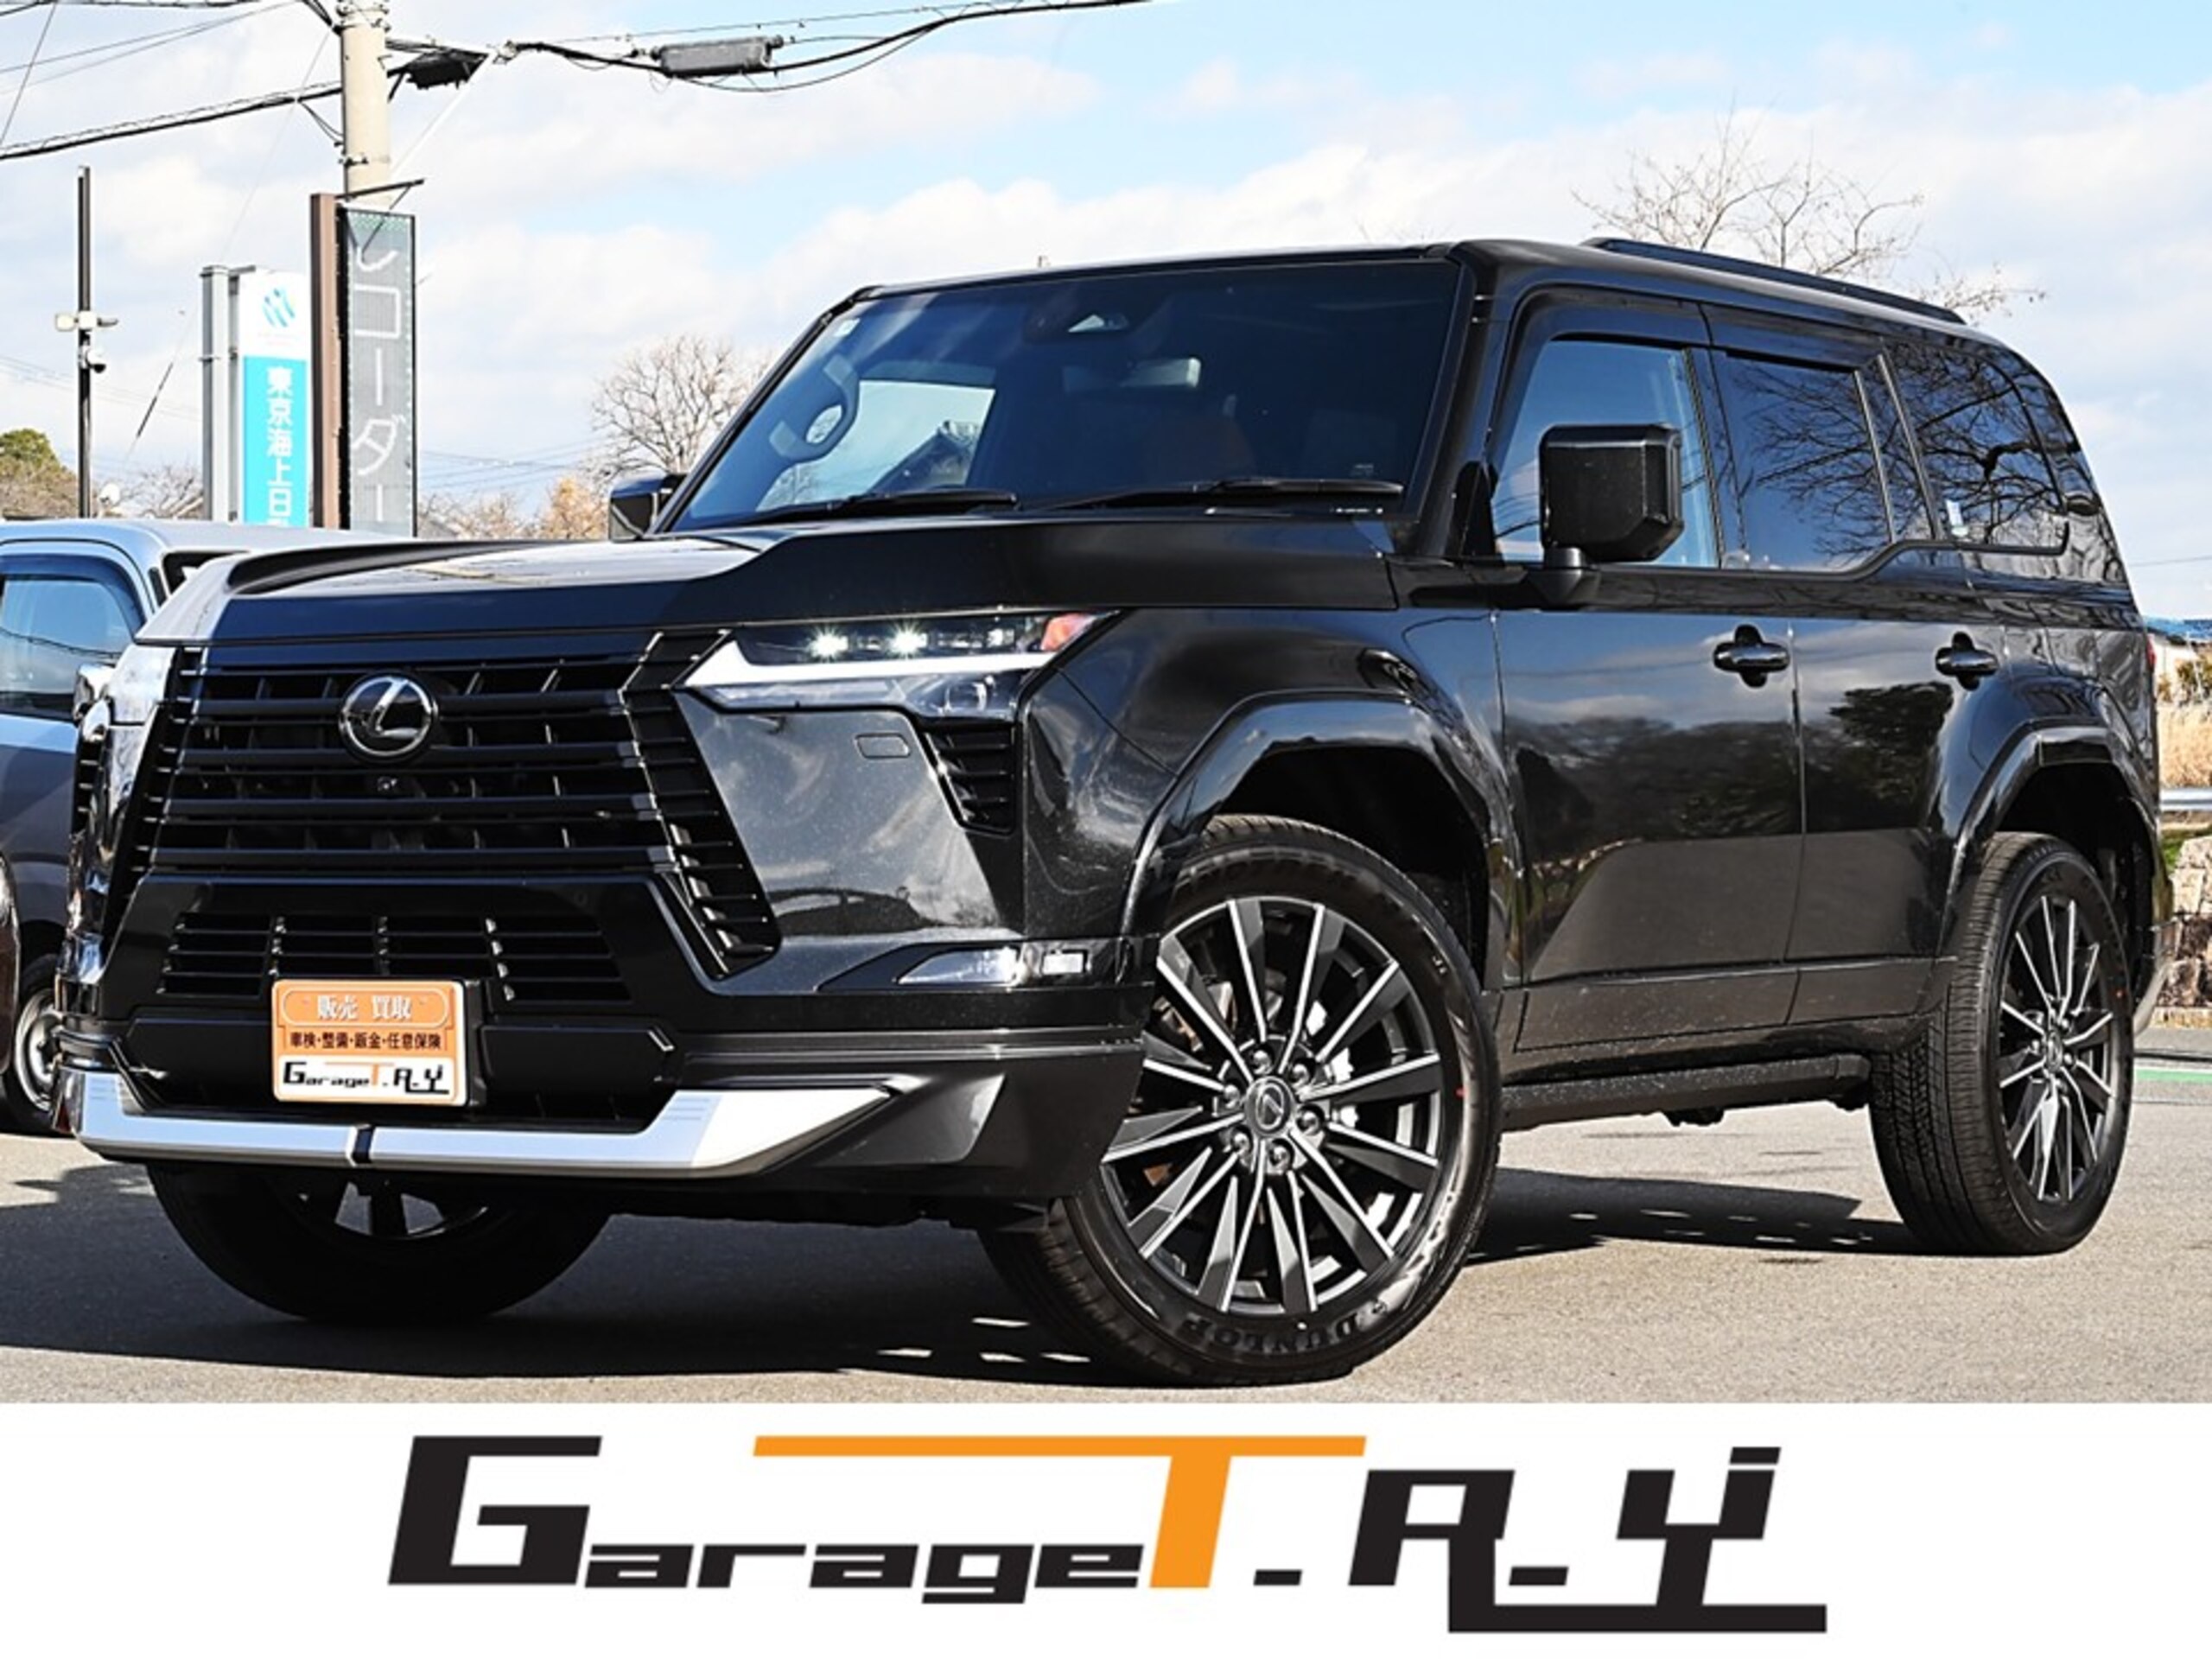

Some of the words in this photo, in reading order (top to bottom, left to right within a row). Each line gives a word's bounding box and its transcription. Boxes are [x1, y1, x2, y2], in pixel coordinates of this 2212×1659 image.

[266, 365, 295, 526] 東京海上日
[317, 995, 359, 1020] 販売
[372, 995, 413, 1020] 買取
